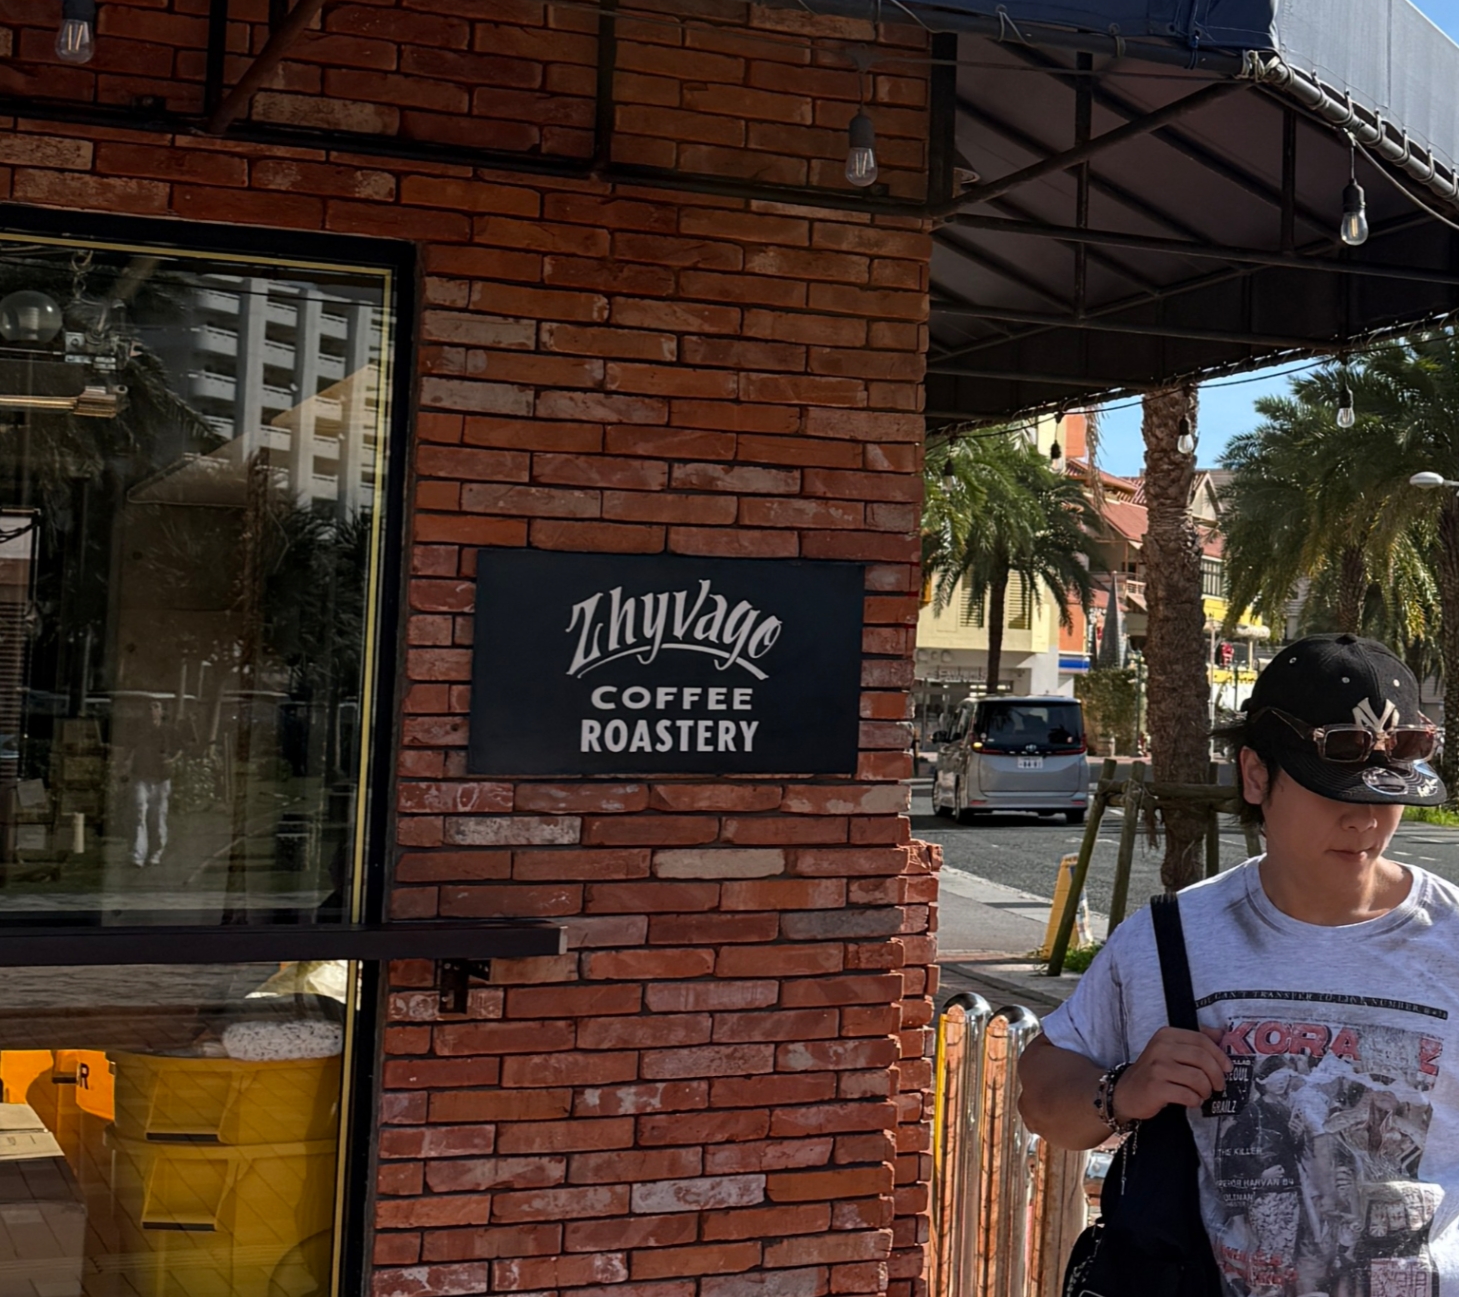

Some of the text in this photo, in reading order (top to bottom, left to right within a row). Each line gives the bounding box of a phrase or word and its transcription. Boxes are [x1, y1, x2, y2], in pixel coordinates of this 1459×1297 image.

[565, 579, 783, 677] Zhyvago
[591, 685, 753, 710] COFFEE
[580, 718, 760, 753] ROASTERY
